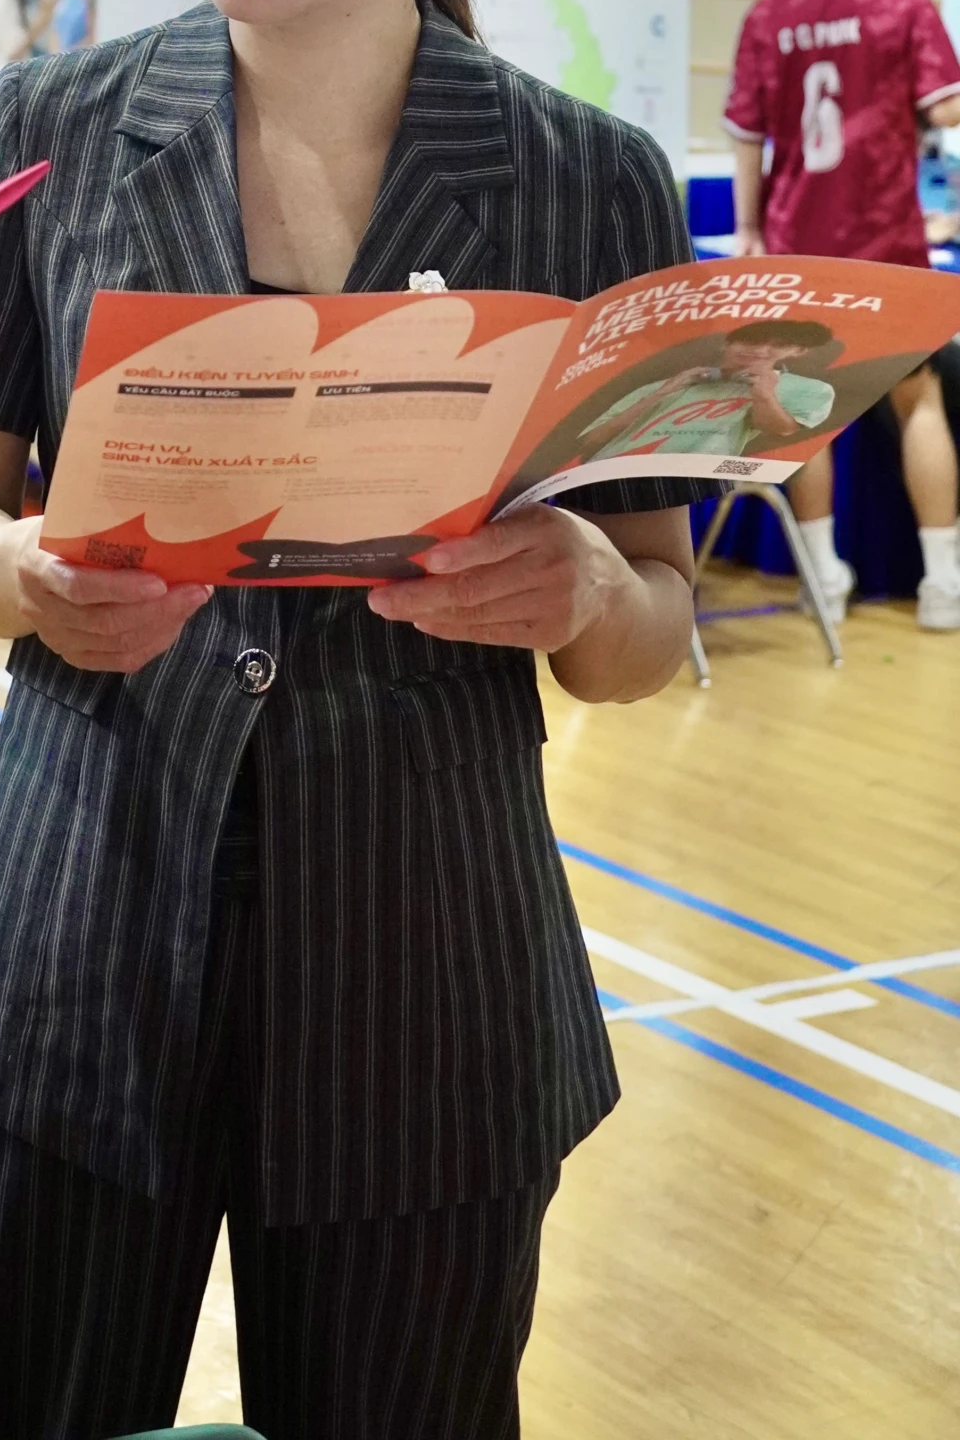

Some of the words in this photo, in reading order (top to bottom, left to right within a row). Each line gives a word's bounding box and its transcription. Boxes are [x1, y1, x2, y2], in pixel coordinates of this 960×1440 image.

[801, 61, 845, 173] 6
[584, 289, 884, 340] METROPOLIA
[595, 273, 803, 321] FINLAND
[578, 304, 790, 356] VIETNAM
[308, 369, 360, 380] SINH
[101, 451, 150, 464] SINH
[104, 440, 155, 452] DỊCH
[159, 444, 192, 456] VỤ
